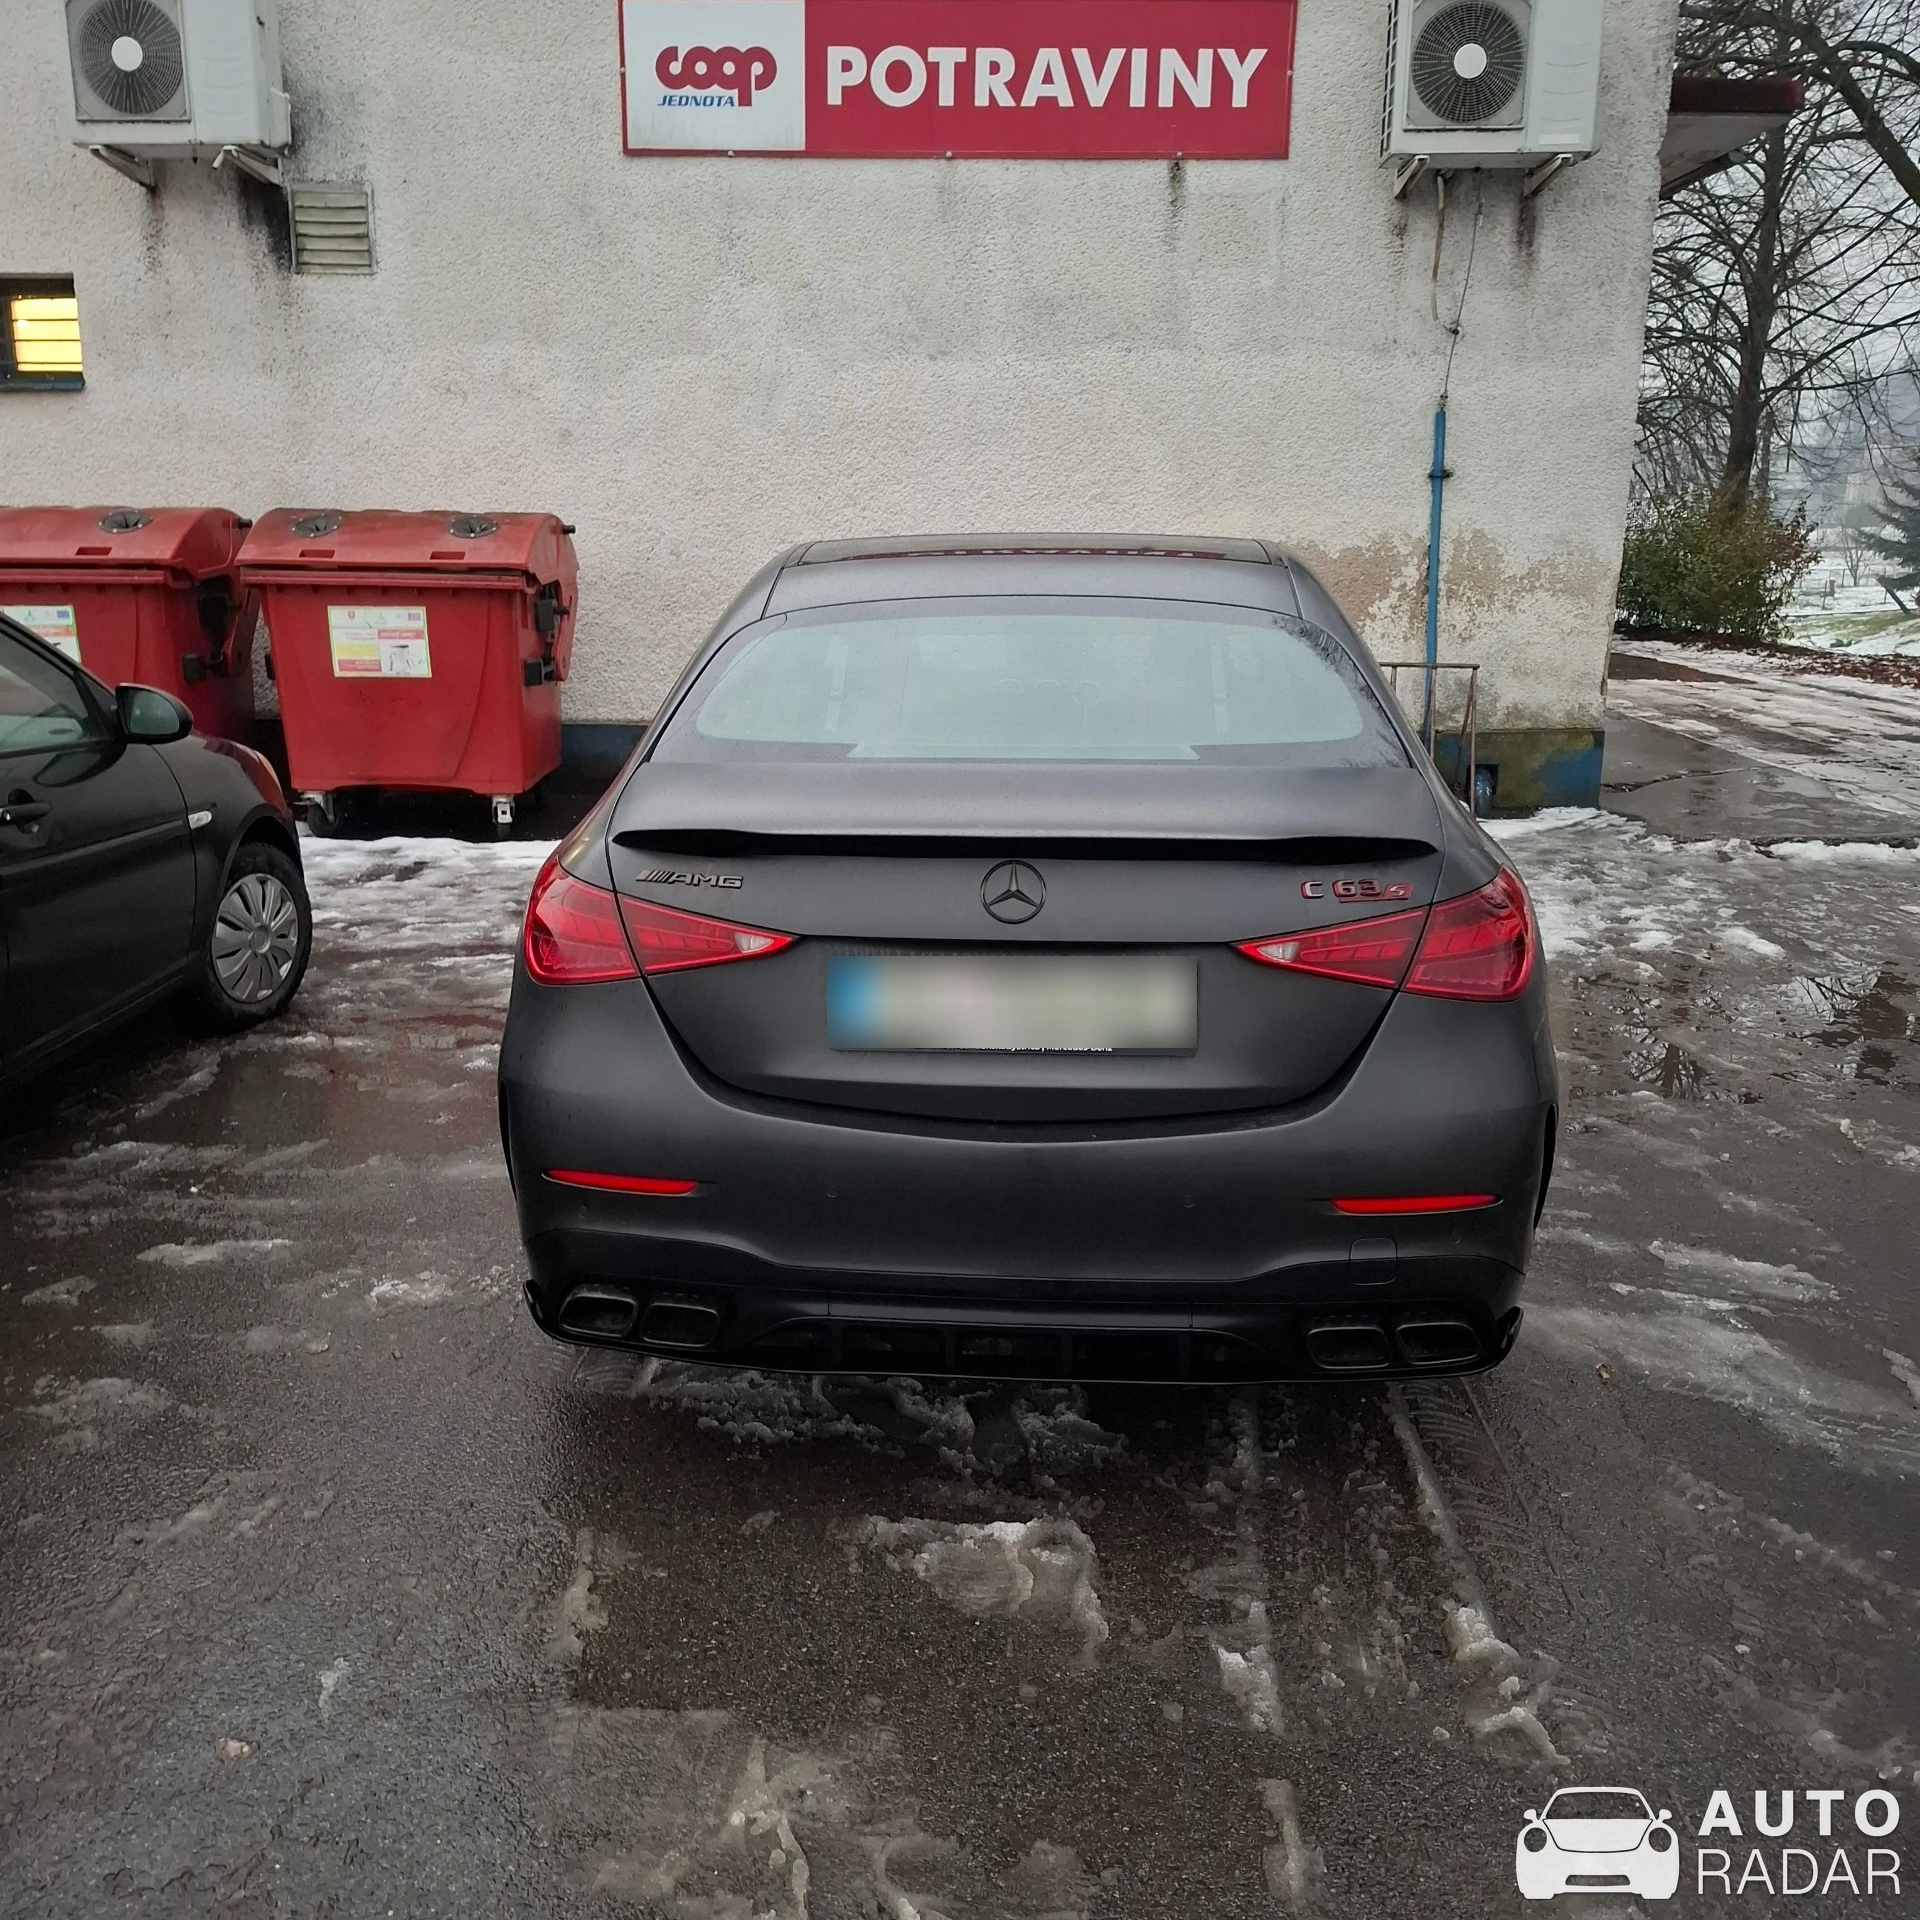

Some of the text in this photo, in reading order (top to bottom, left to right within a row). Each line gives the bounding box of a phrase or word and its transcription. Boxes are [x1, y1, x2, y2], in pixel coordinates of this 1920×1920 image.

[655, 45, 778, 107] coop
[826, 44, 1268, 108] POTRAVINY
[657, 94, 735, 107] JEDNOTA
[664, 871, 744, 889] AMG
[1301, 881, 1324, 899] C
